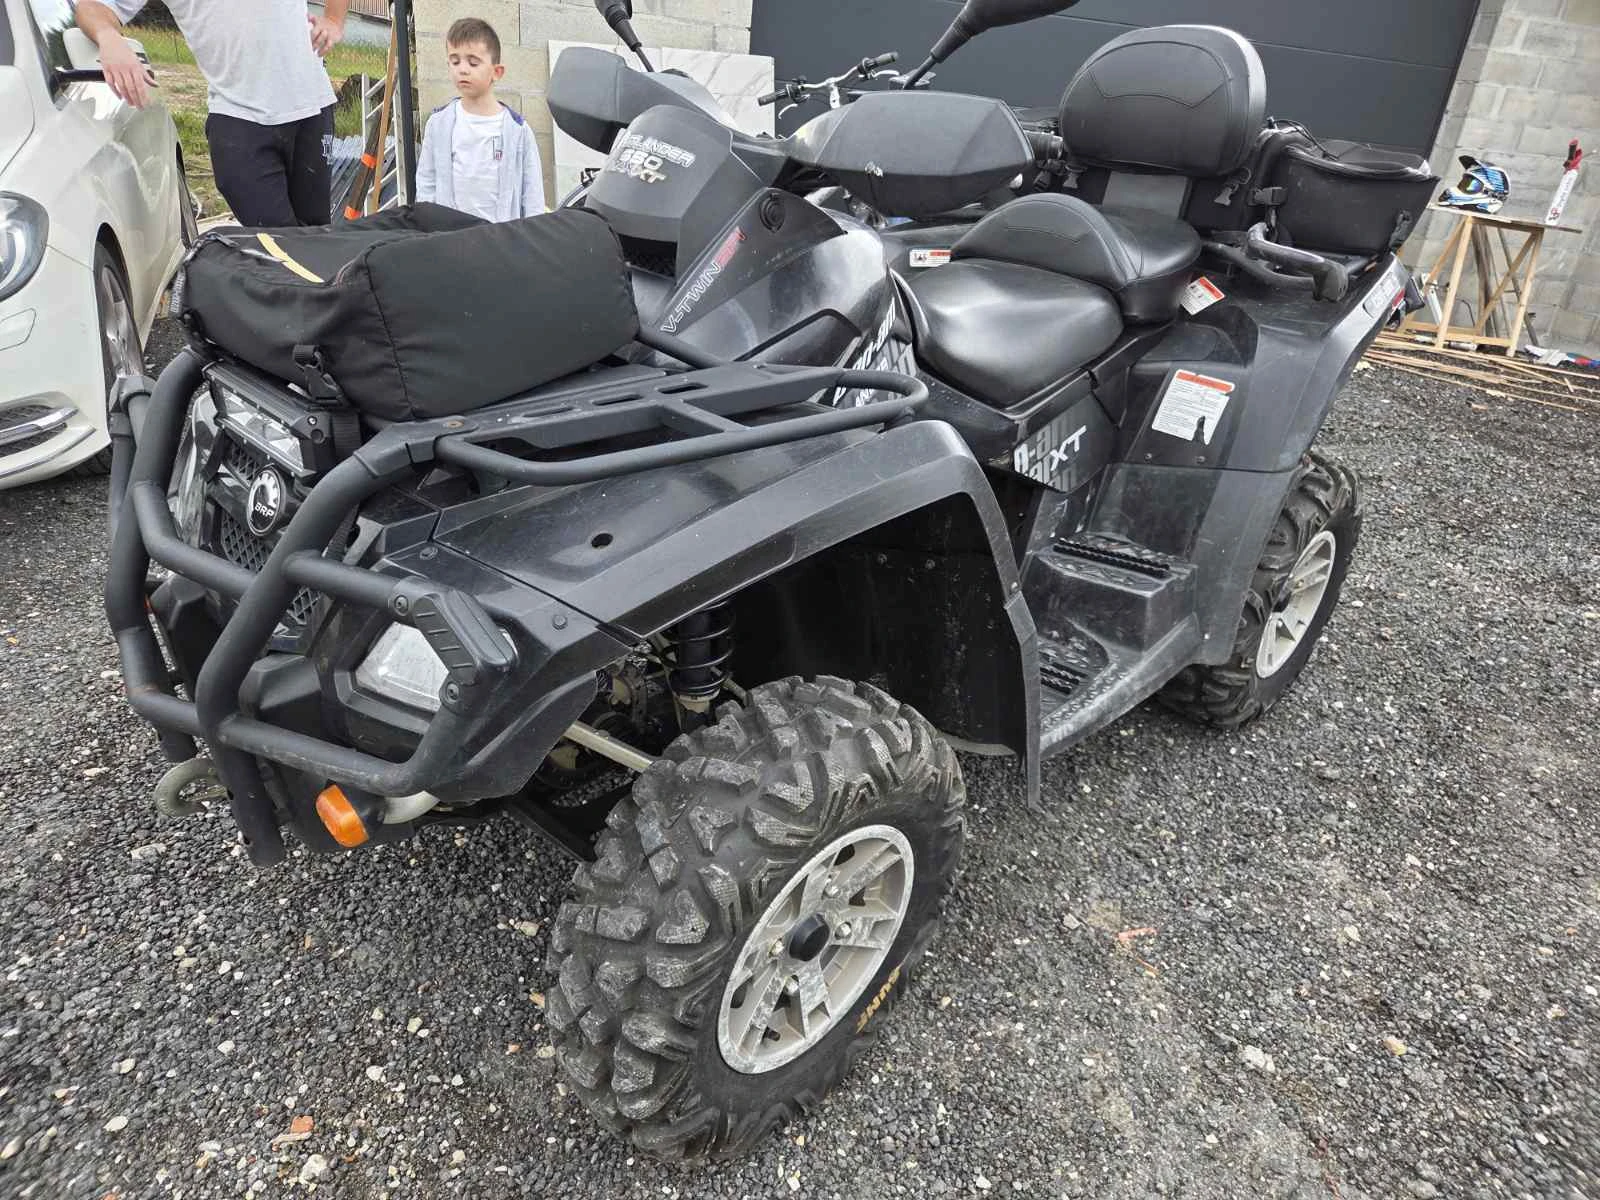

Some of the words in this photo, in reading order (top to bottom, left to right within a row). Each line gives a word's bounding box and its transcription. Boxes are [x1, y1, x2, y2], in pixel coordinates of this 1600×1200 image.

[660, 259, 721, 333] V-TWIN
[1049, 424, 1087, 472] XT
[254, 501, 275, 517] BRP
